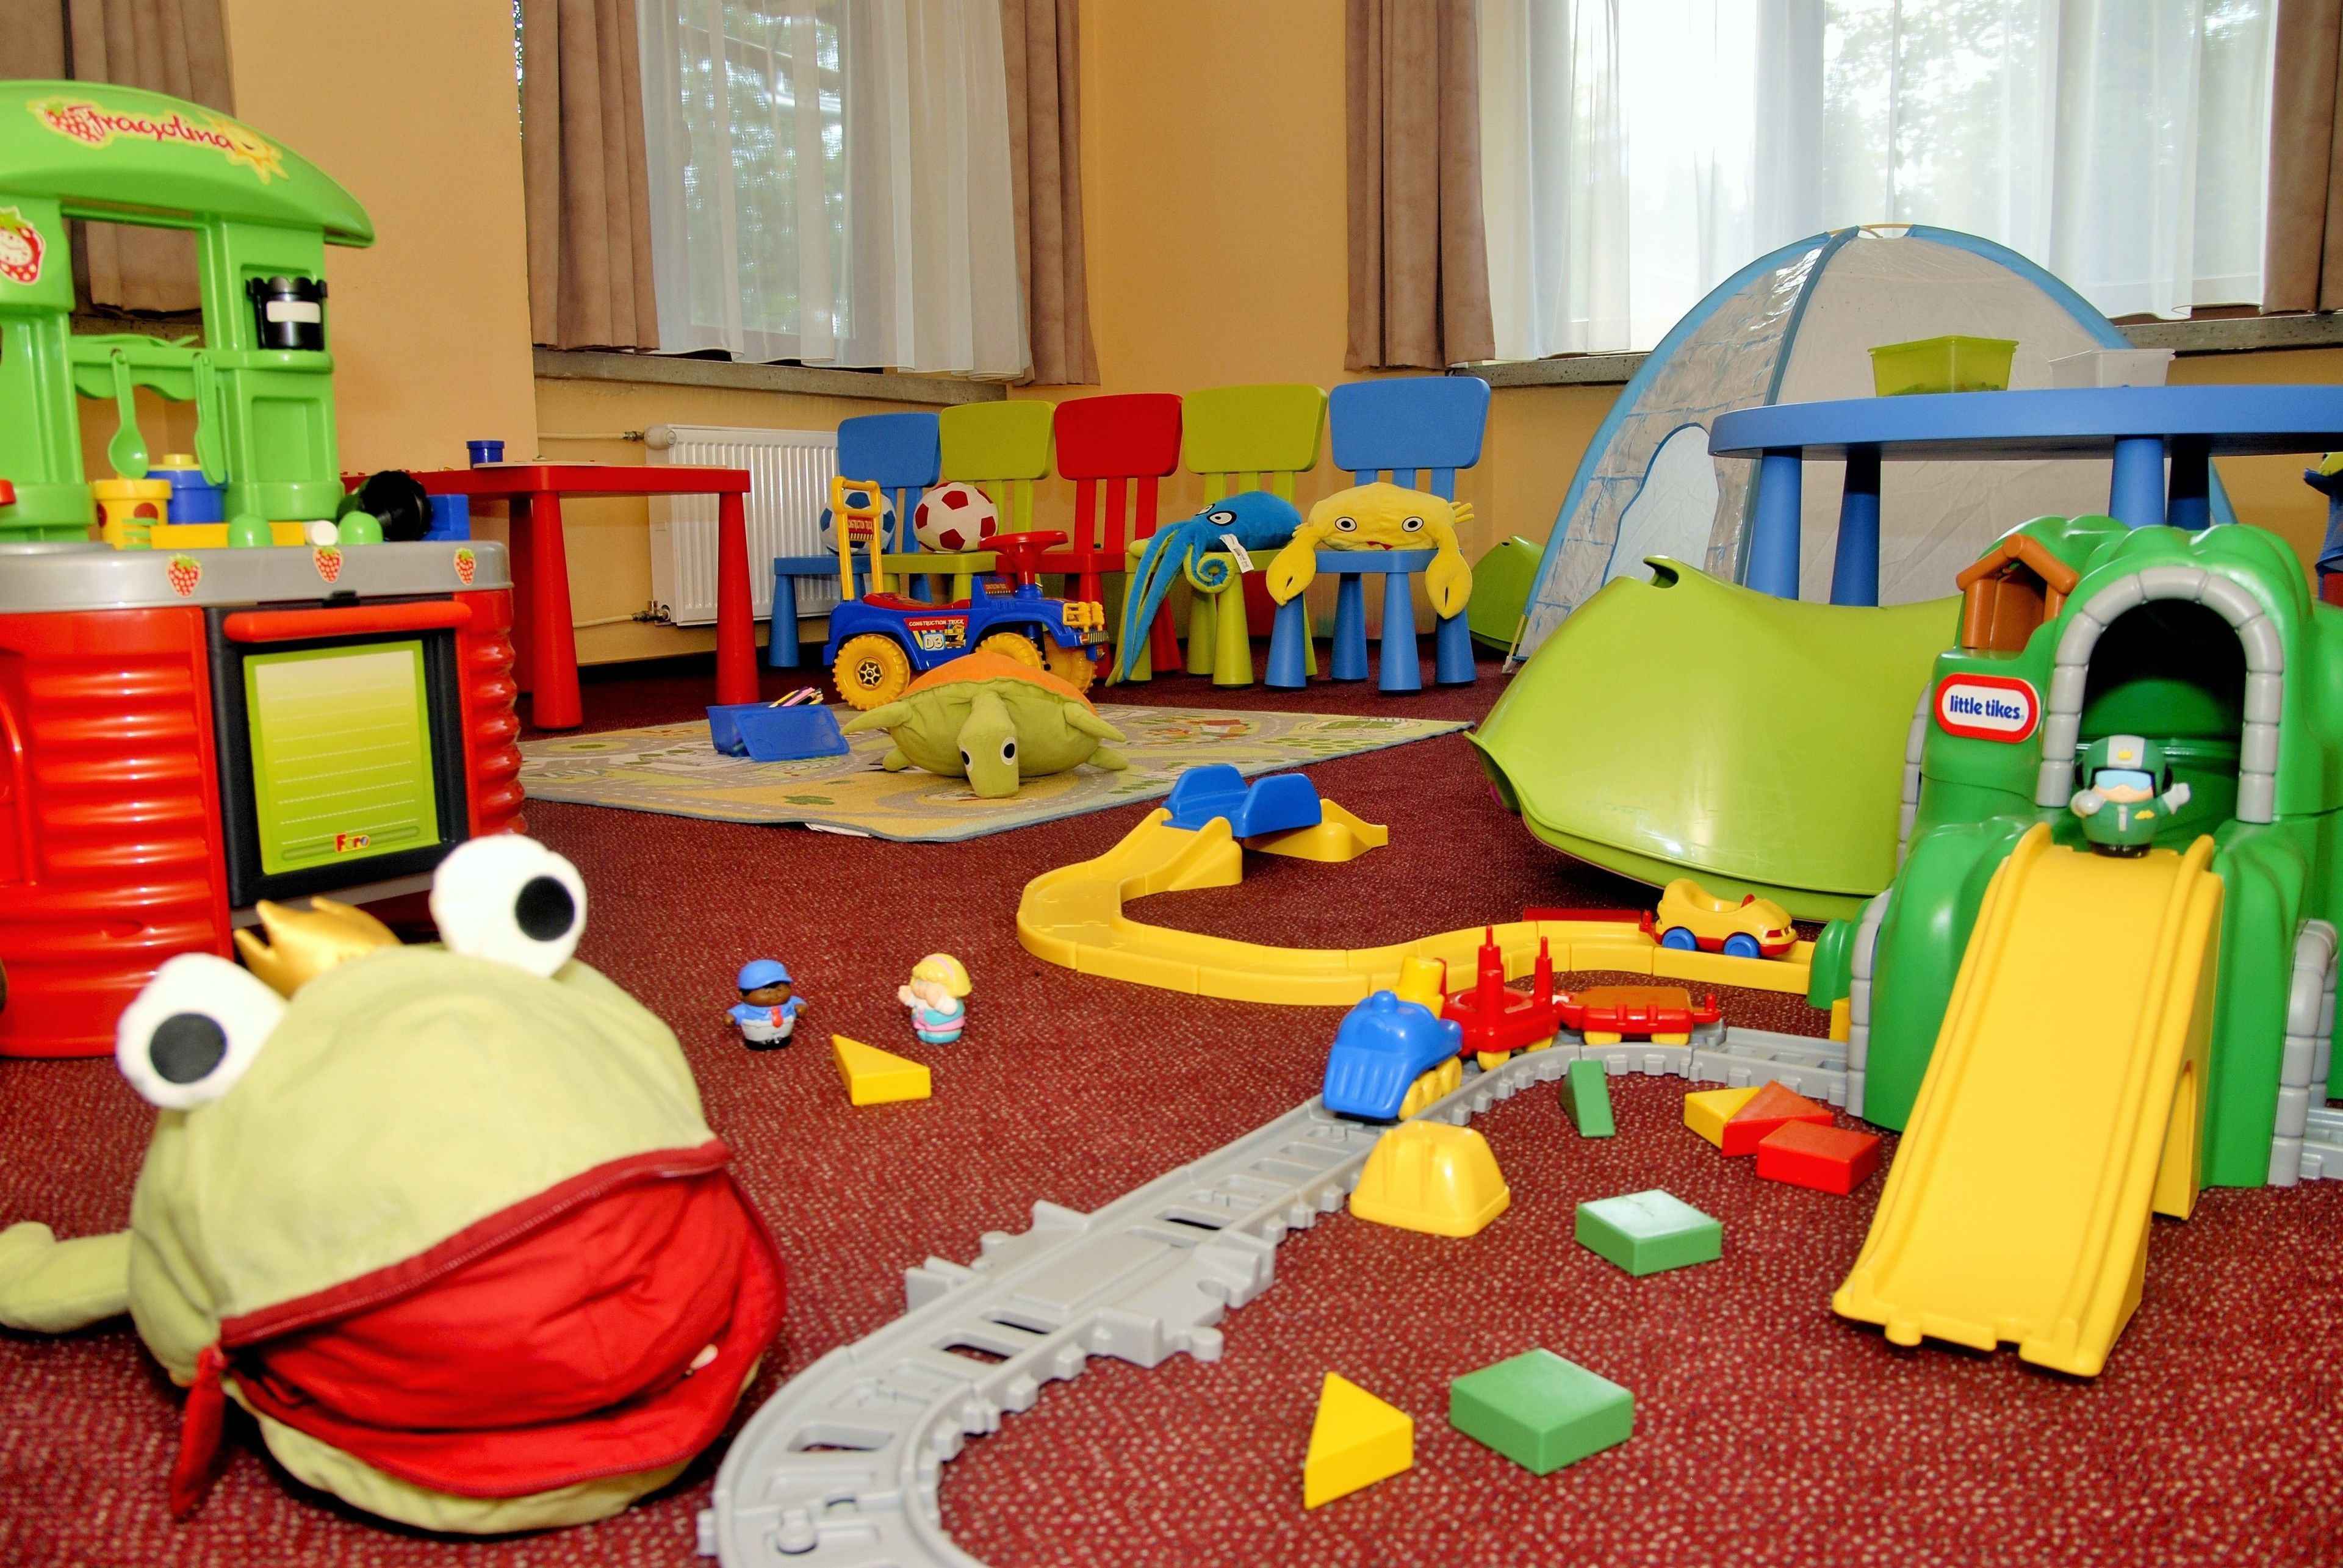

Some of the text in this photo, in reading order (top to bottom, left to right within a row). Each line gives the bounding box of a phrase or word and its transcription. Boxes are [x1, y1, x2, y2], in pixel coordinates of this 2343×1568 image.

[926, 636, 943, 649] D3
[1949, 695, 2021, 720] little tikes
